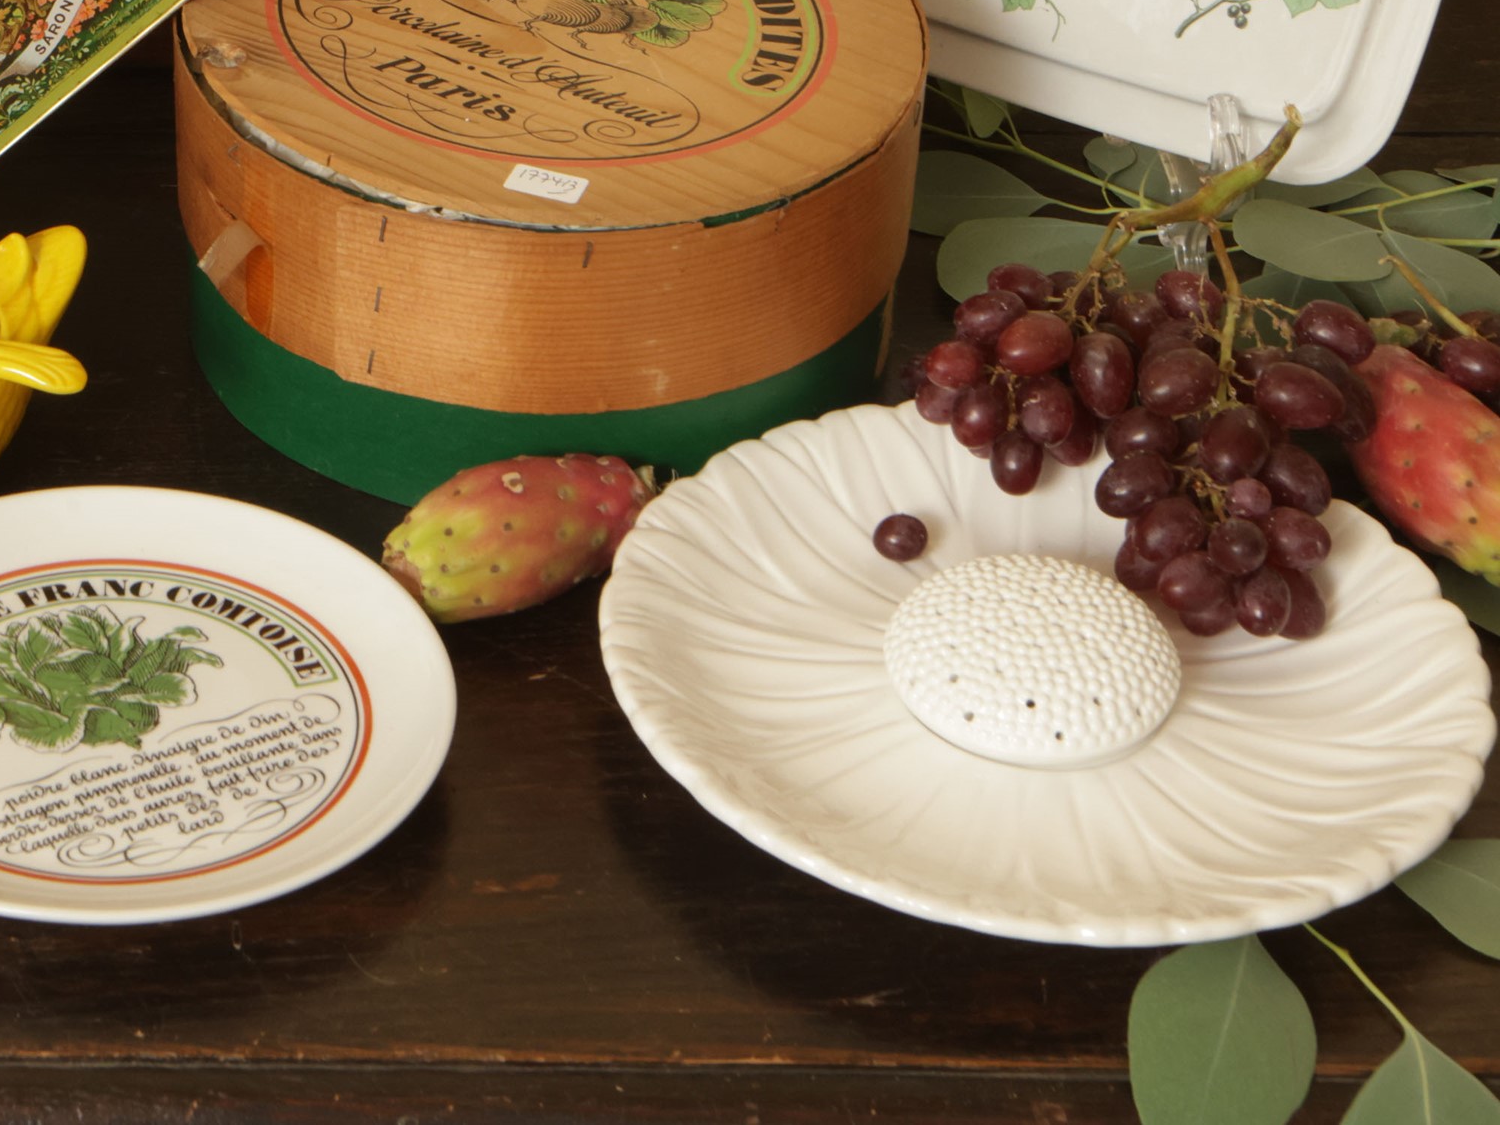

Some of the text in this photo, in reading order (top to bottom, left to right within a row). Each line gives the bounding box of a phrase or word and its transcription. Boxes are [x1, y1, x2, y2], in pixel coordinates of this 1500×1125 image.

[371, 55, 517, 123] Paris
[497, 57, 683, 128] d'Auteuil
[14, 579, 155, 608] FRANC
[165, 585, 329, 680] COMTOISE
[195, 752, 222, 765] au
[222, 725, 299, 755] moment
[299, 715, 323, 729] de
[218, 725, 246, 740] de
[17, 824, 95, 854] laquelle
[142, 790, 204, 815] aurez
[207, 771, 246, 797] fait
[246, 758, 295, 783] frire
[294, 747, 330, 763] des
[105, 794, 130, 809] de
[133, 774, 196, 800] l'huile
[201, 741, 299, 778] bouillante
[301, 726, 342, 745] dans
[120, 811, 180, 842] petits
[230, 787, 258, 801] de
[177, 809, 225, 834] lard
